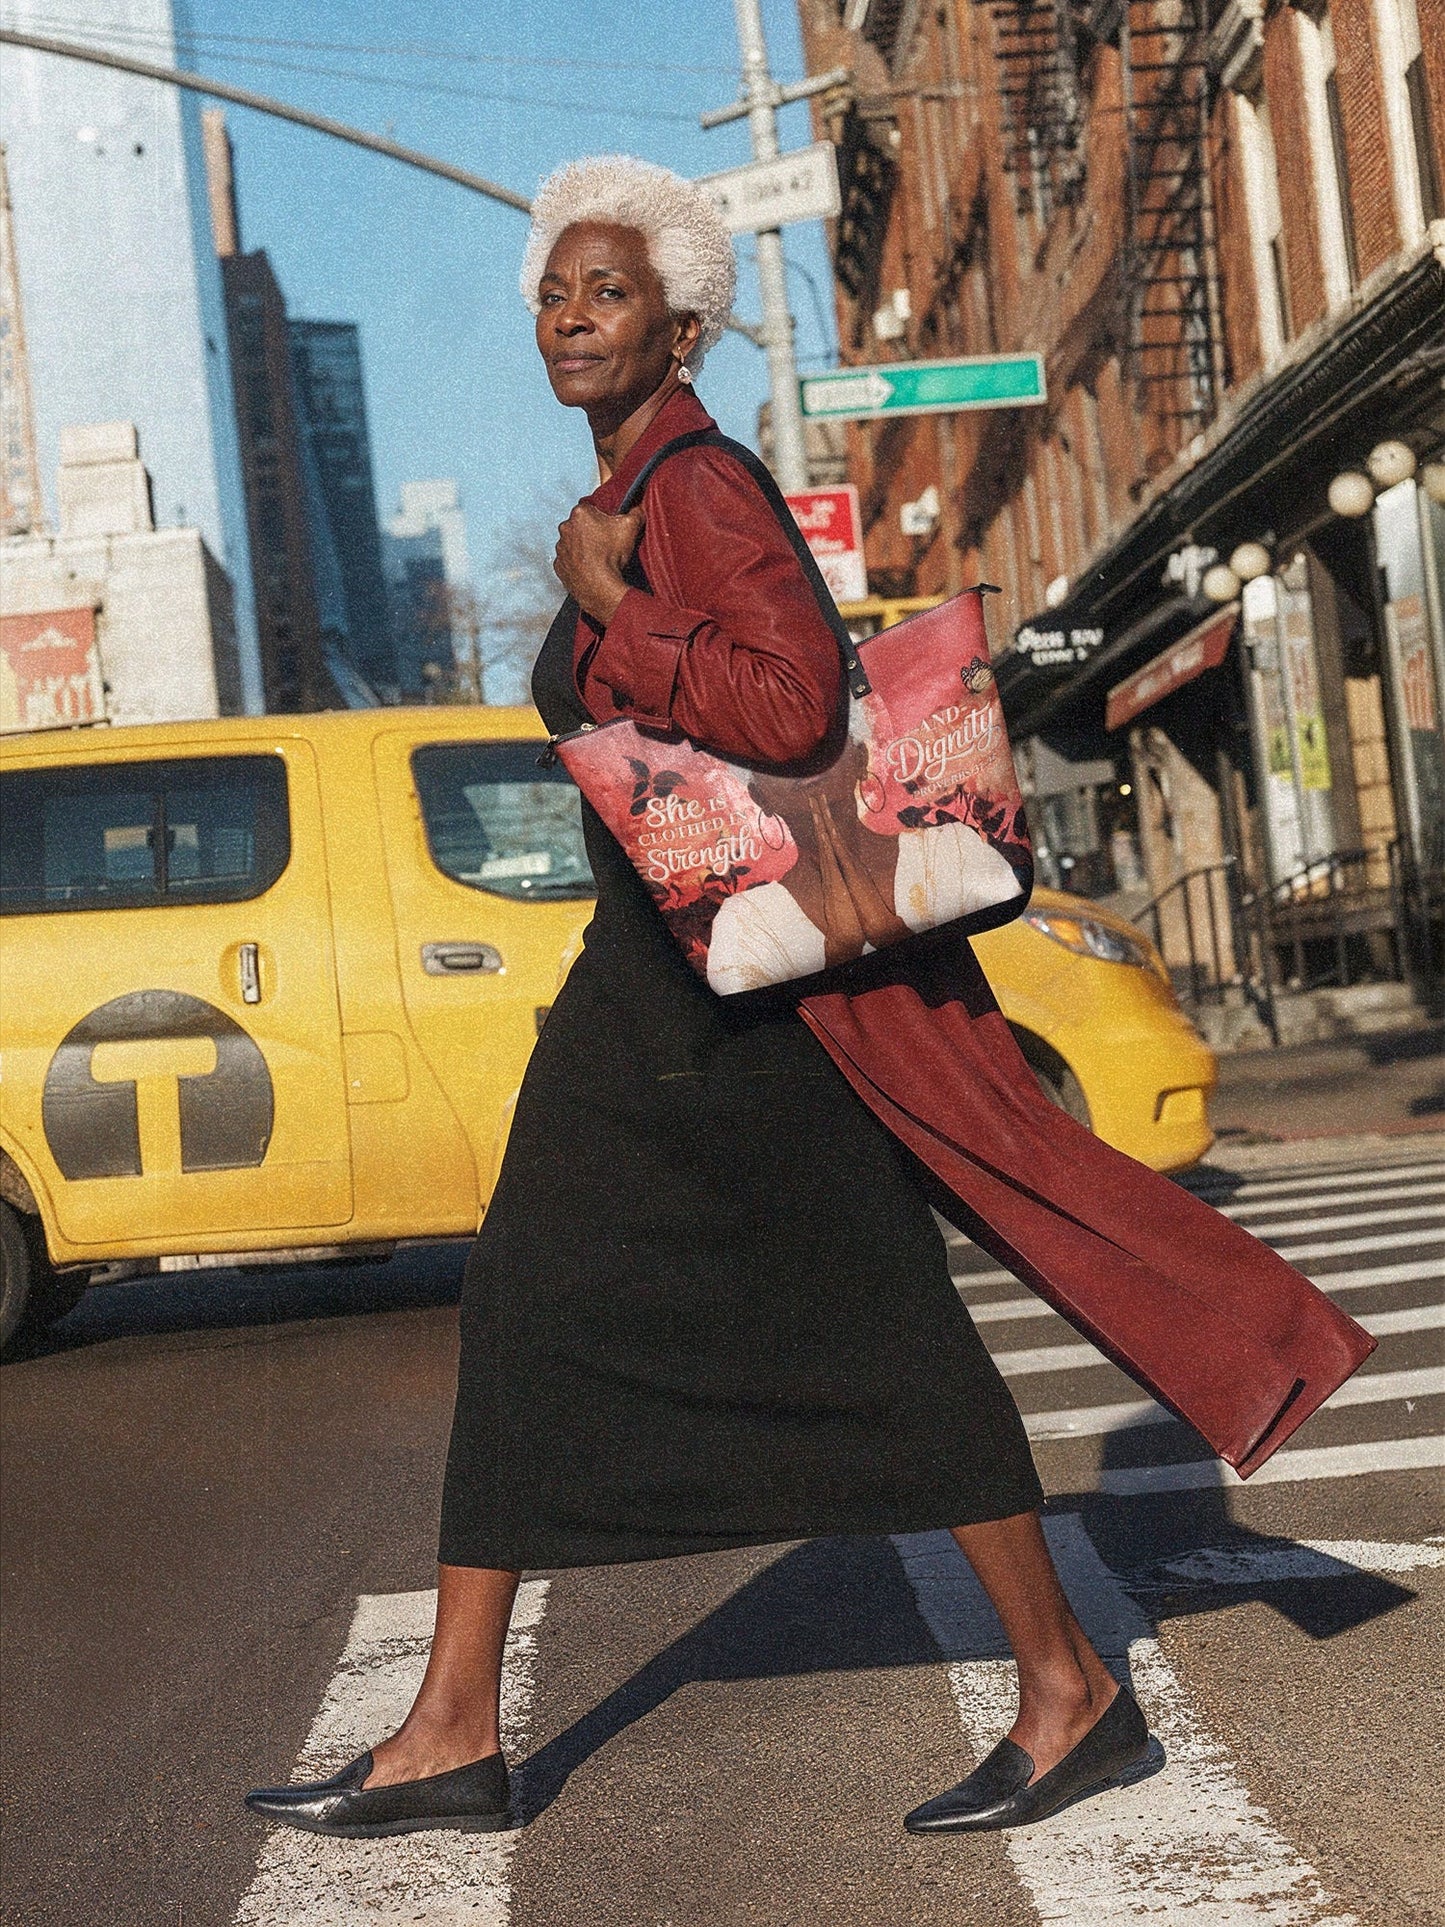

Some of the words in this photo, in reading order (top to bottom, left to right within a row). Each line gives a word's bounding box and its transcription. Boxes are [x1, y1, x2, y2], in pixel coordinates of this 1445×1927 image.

[885, 700, 1001, 783] Dignity
[638, 817, 724, 847] CLOTHED
[729, 808, 748, 826] IN
[646, 793, 705, 828] She
[708, 793, 727, 812] IS
[646, 824, 762, 881] Strength
[90, 1035, 218, 1178] T
